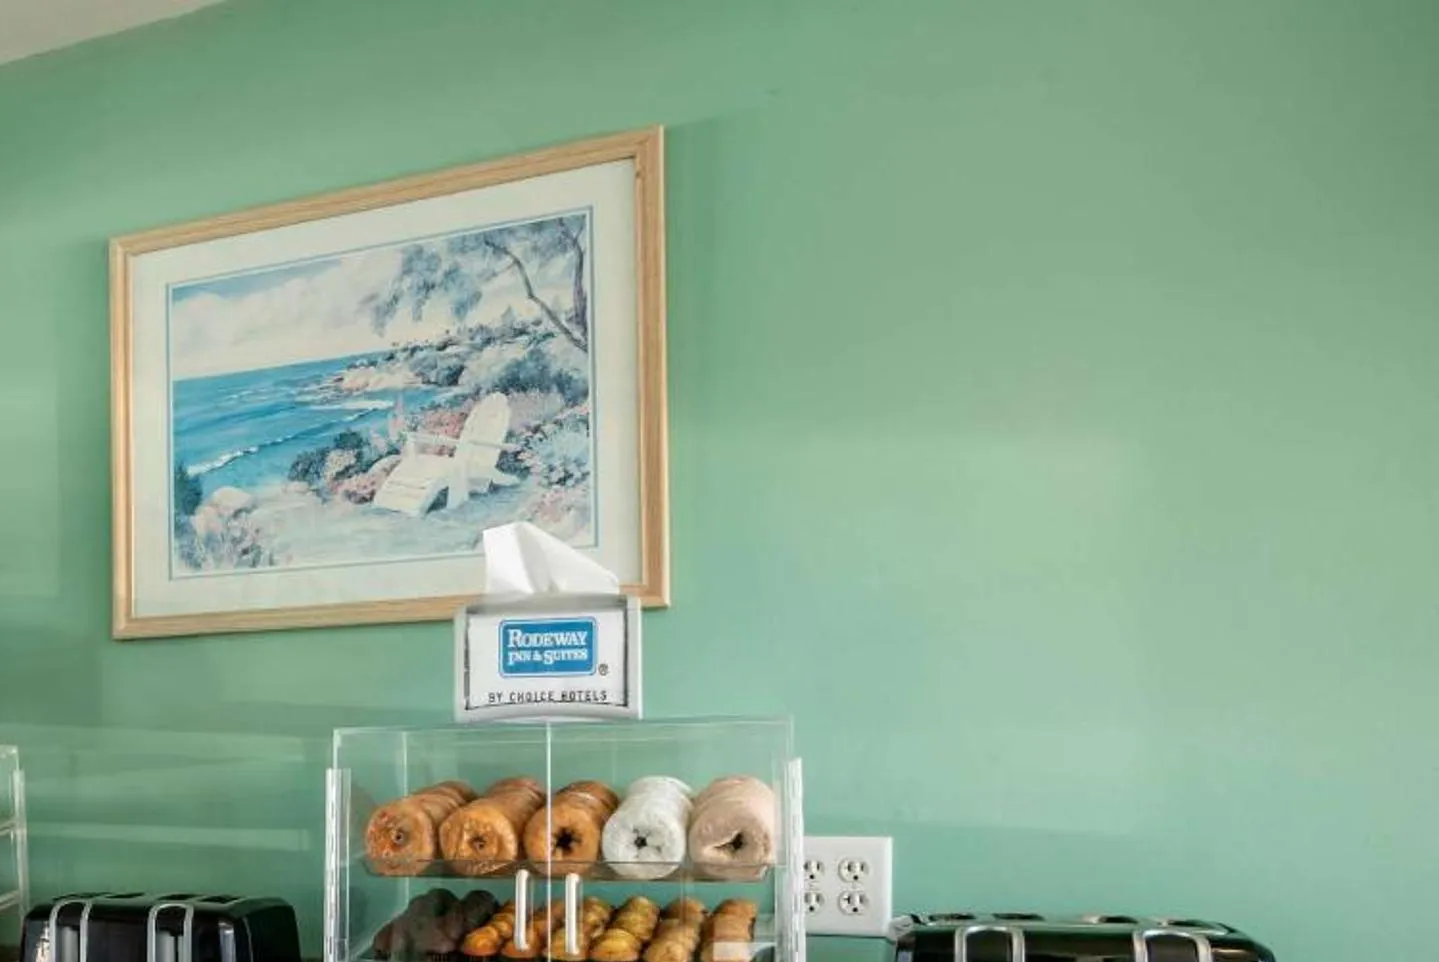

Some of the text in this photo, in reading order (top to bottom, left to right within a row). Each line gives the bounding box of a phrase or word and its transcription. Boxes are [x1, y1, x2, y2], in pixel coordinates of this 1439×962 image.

[507, 628, 589, 648] RODEWAY
[507, 648, 589, 666] INN & SUITES
[488, 689, 608, 703] BY CHOICE HOTELS
